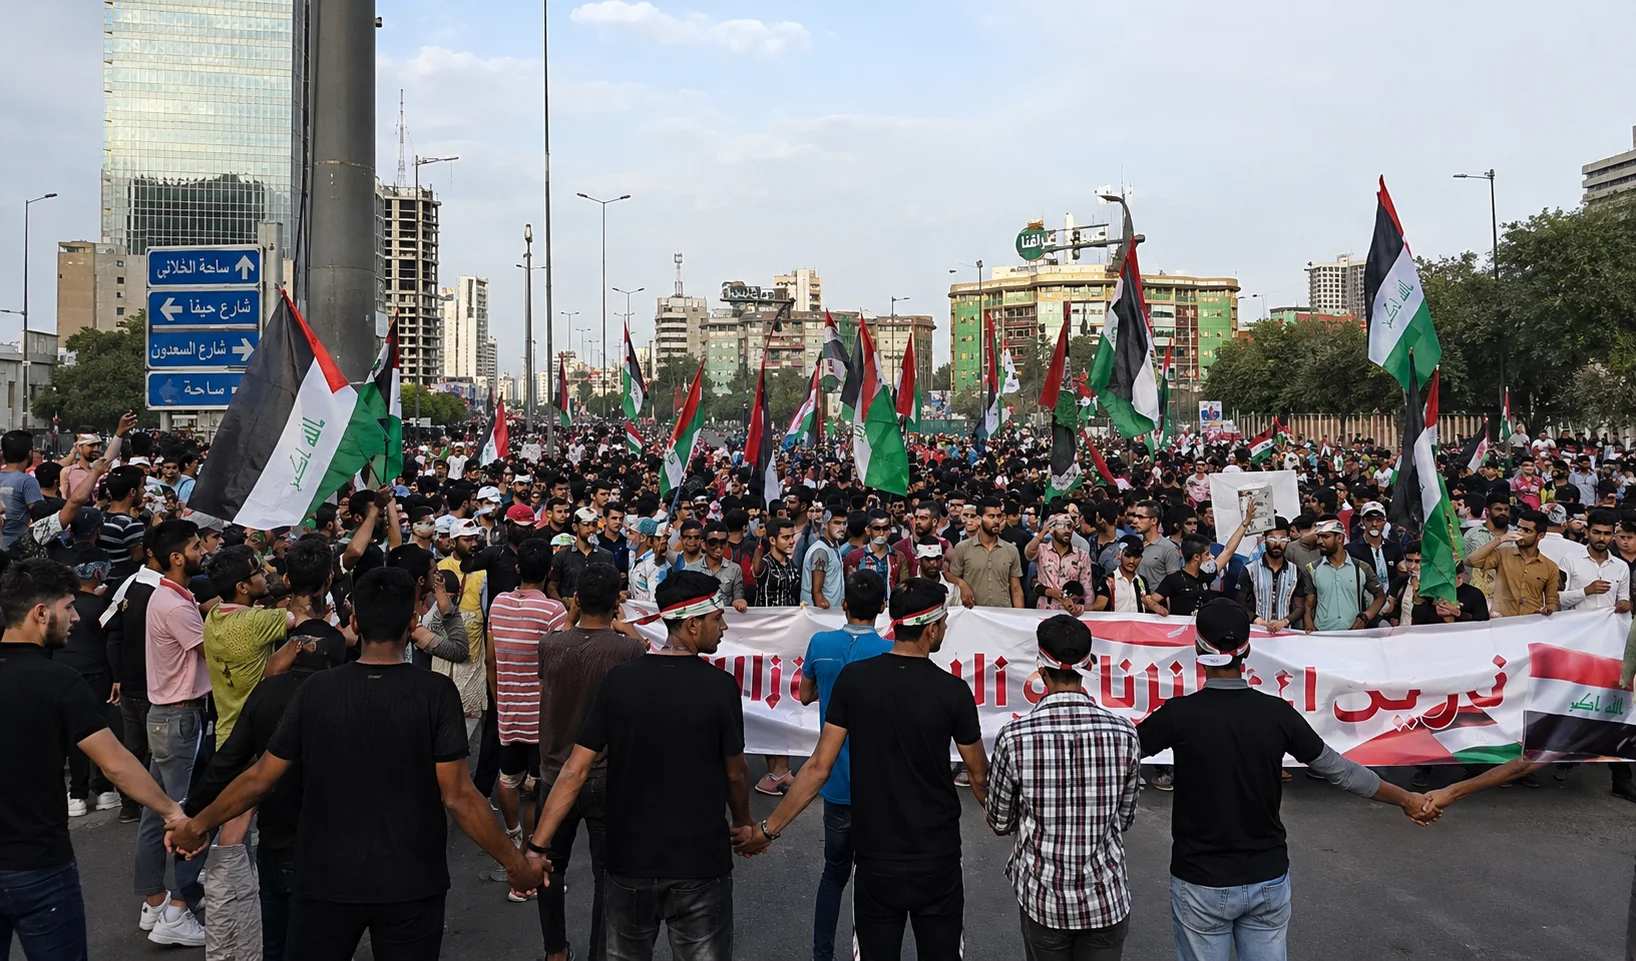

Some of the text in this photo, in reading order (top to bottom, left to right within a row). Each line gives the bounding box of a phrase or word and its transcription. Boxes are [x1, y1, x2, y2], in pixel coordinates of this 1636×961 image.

[156, 258, 230, 279] ساحة الخلاني
[189, 298, 251, 320] شارع حيفا
[151, 340, 227, 361] شارع السعدون
